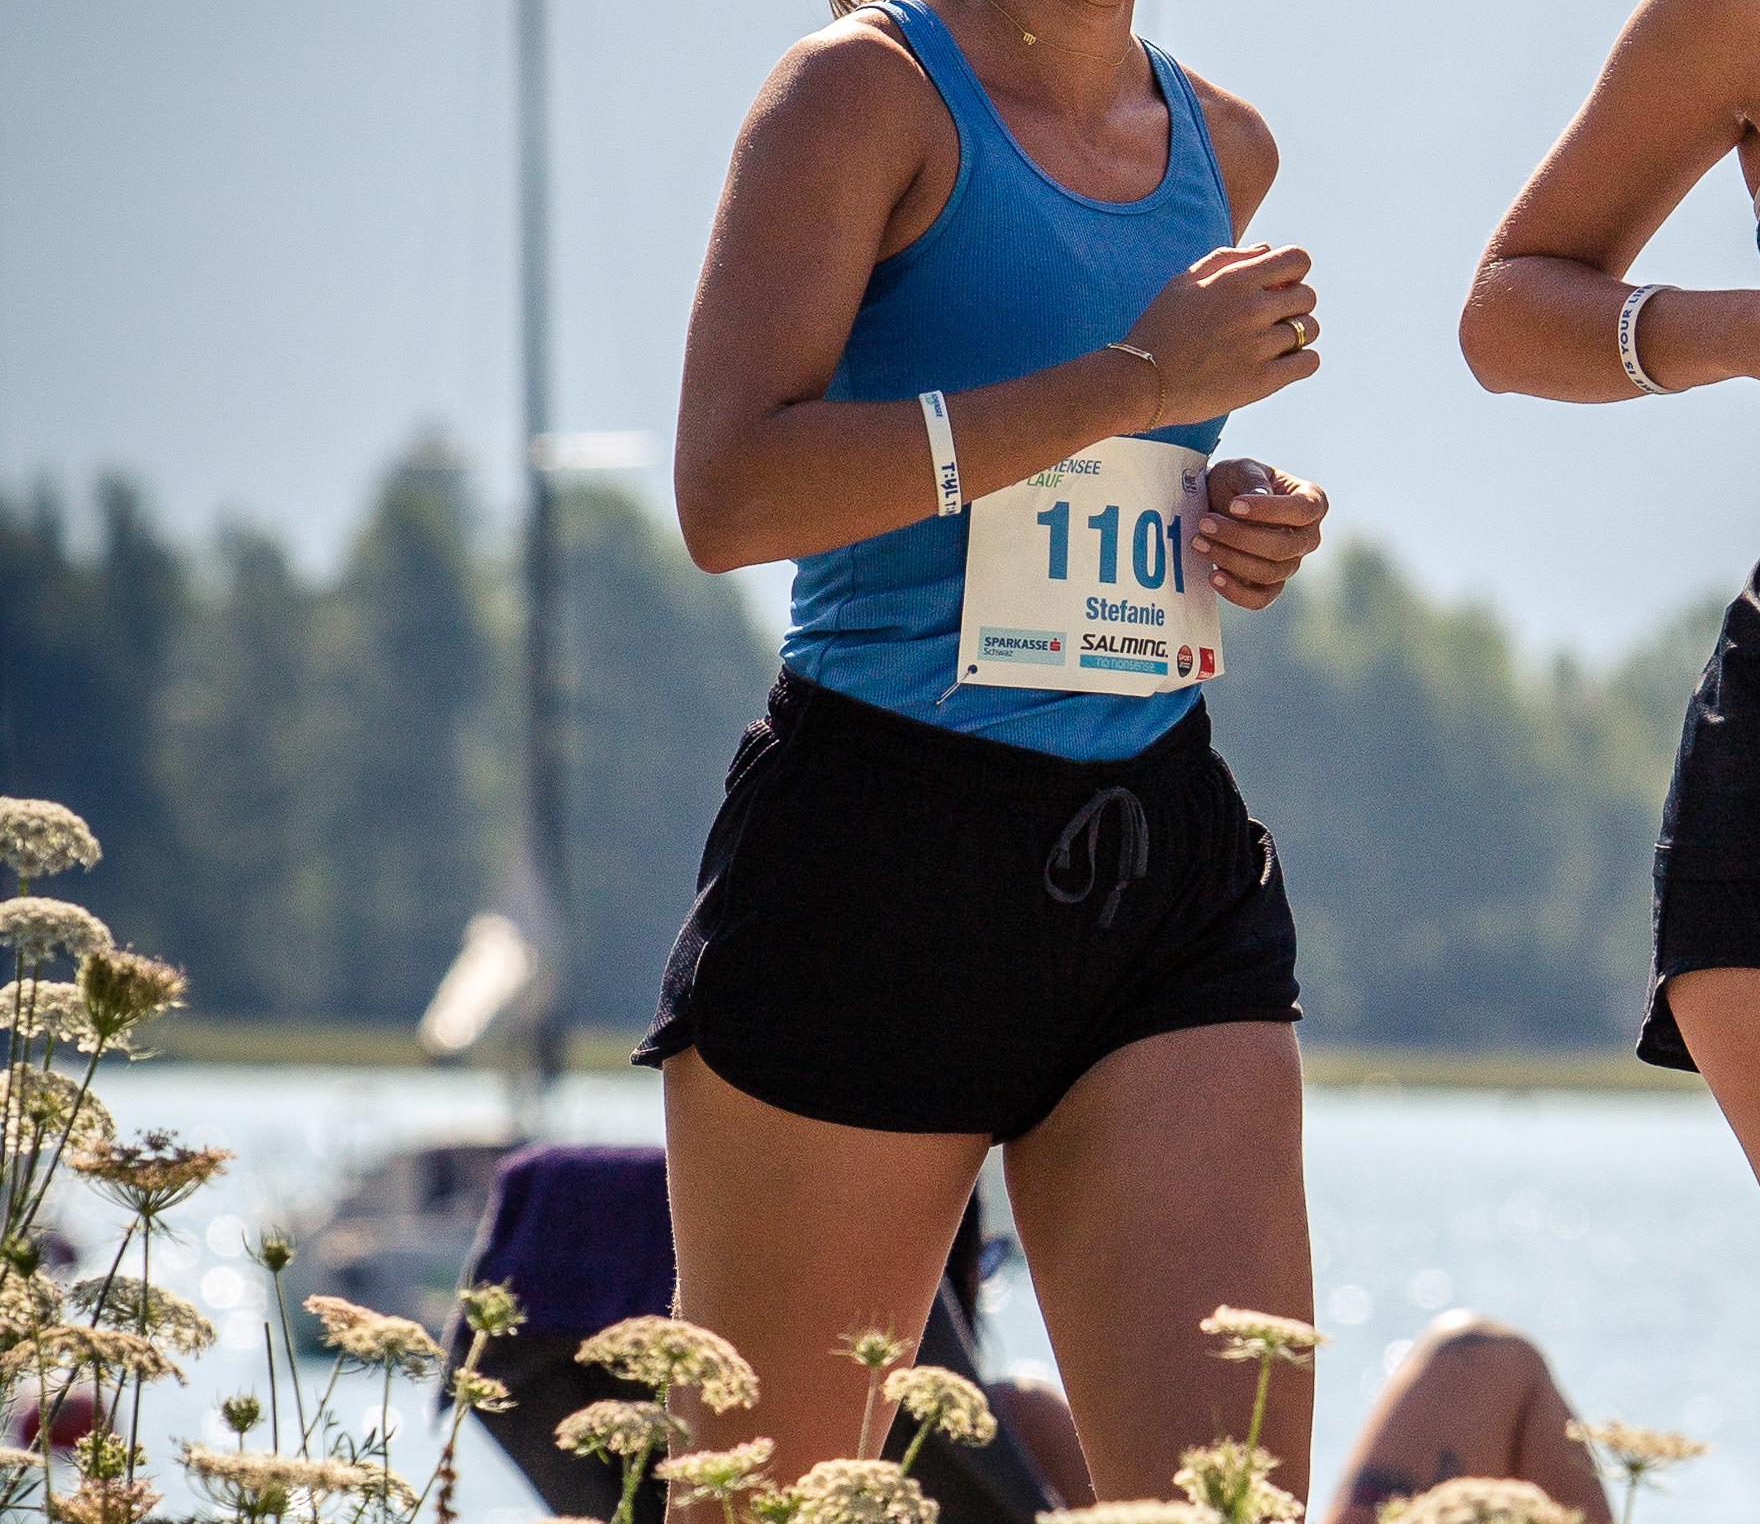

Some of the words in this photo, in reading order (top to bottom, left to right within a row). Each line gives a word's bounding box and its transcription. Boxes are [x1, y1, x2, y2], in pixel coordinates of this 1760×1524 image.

[1620, 309, 1633, 355] YOUR
[1037, 501, 1185, 594] 1101
[1085, 596, 1165, 627] Stefanie
[984, 637, 1049, 651] SPARKASSE
